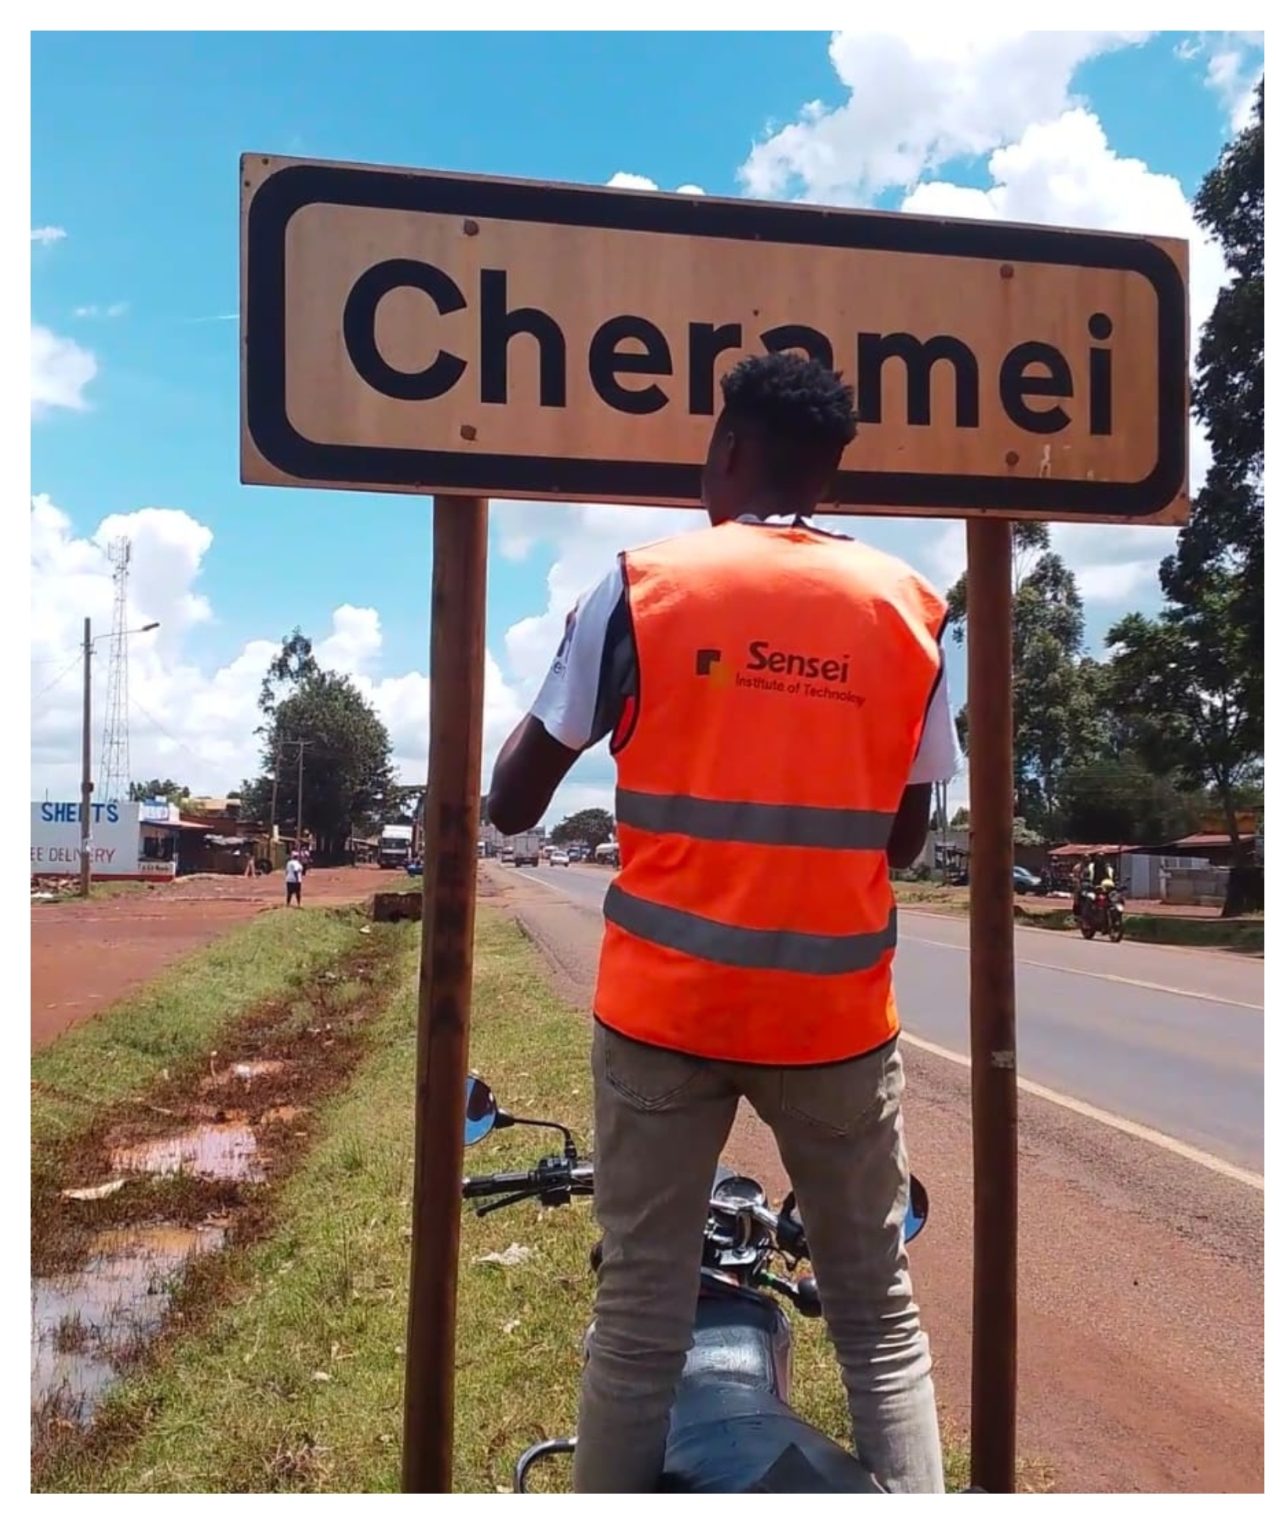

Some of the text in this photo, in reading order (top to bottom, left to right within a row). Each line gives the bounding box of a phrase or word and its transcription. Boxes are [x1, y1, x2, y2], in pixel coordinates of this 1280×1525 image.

[746, 640, 850, 684] Sensei
[736, 673, 785, 692] Institute
[787, 681, 801, 694] of
